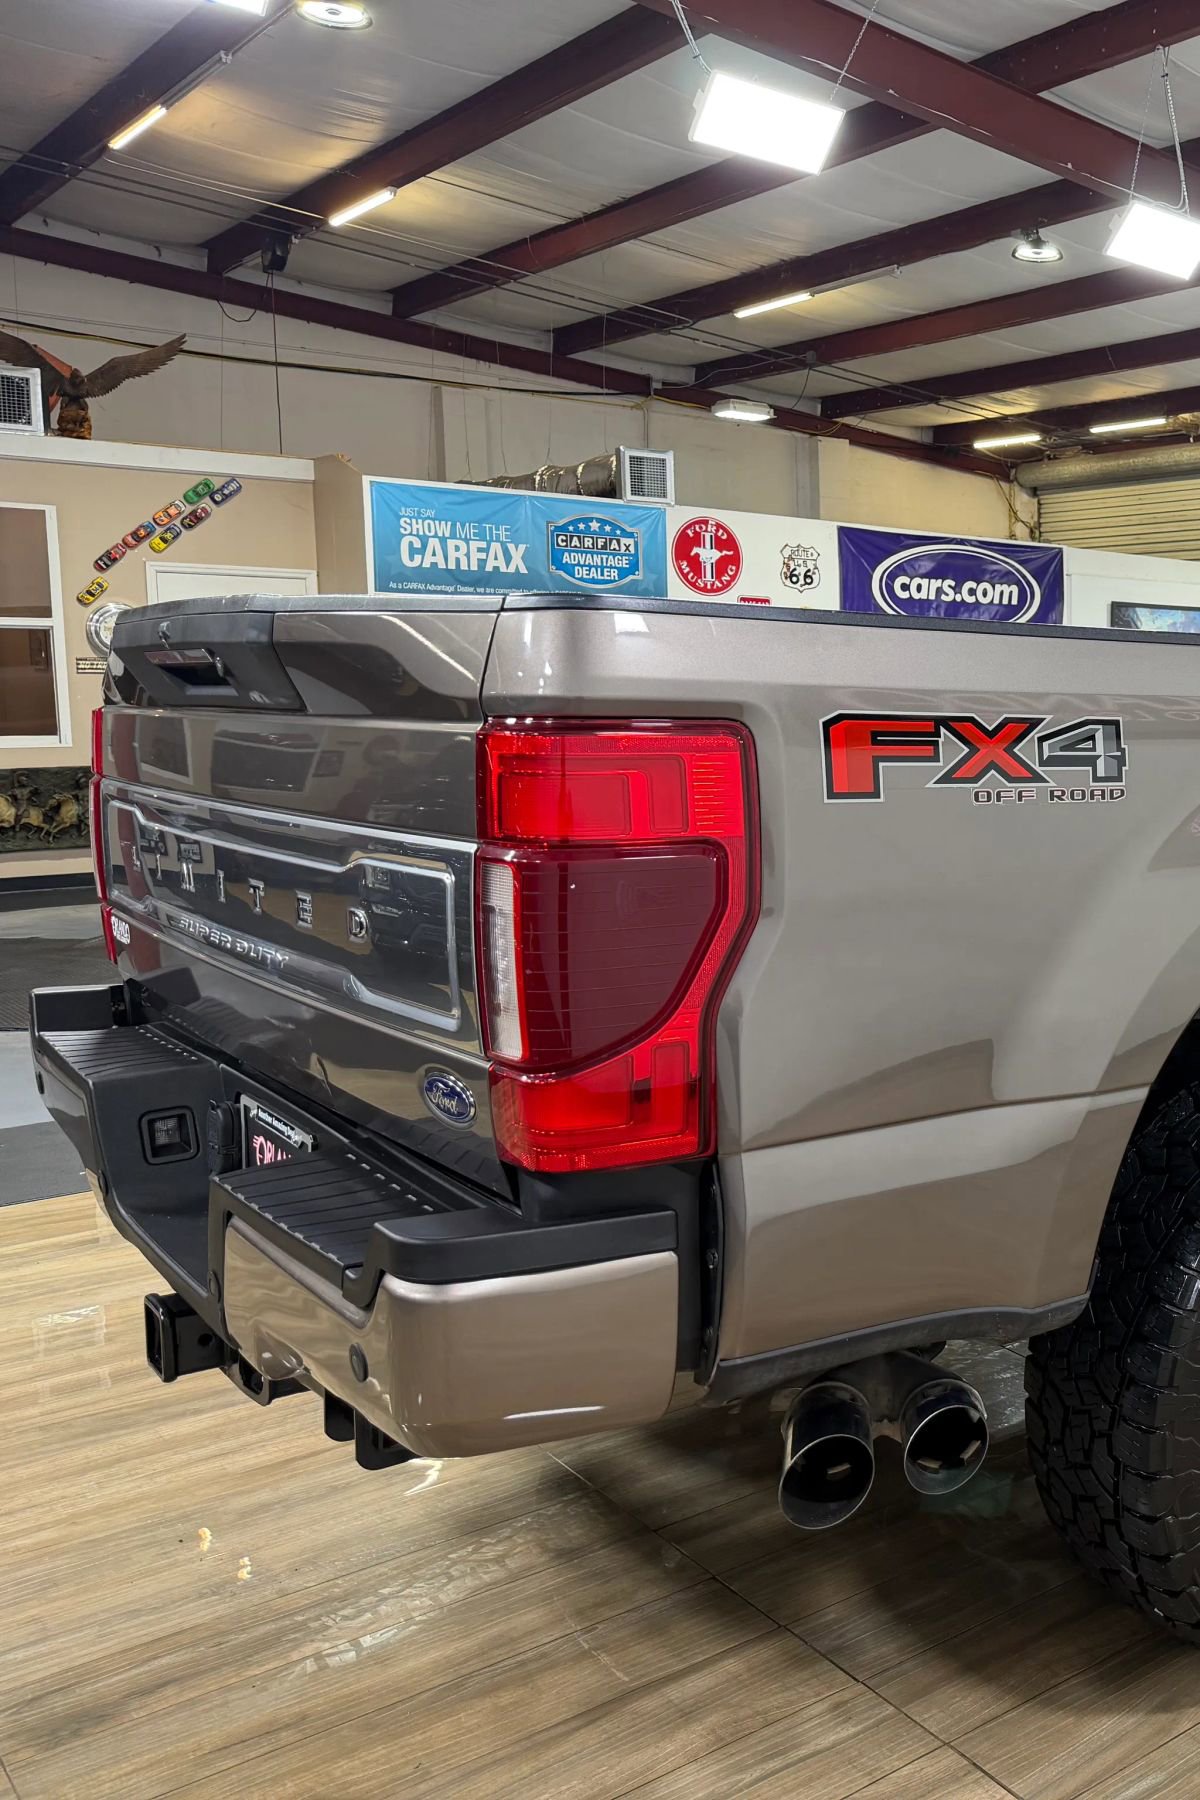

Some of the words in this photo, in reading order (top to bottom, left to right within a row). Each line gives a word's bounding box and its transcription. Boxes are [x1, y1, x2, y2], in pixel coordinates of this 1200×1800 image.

[399, 507, 418, 516] JUST
[421, 509, 435, 518] SAY
[400, 517, 451, 538] SHOW
[456, 521, 479, 539] ME
[483, 523, 511, 541] THE
[685, 522, 728, 540] FORD
[557, 533, 632, 553] CARFAX
[400, 535, 529, 574] CARFAX
[562, 552, 630, 568] ADVANTAGE
[574, 566, 619, 580] DEALER
[679, 559, 737, 590] MUSTANG
[389, 581, 397, 589] As
[403, 582, 426, 590] CARFAX
[893, 576, 1018, 606] cars.com
[819, 709, 1130, 803] FX4
[972, 786, 1037, 805] OFF
[1048, 785, 1127, 802] ROAD
[180, 916, 232, 949] SUPER
[236, 938, 289, 970] DUTY
[431, 1081, 459, 1114] Ford
